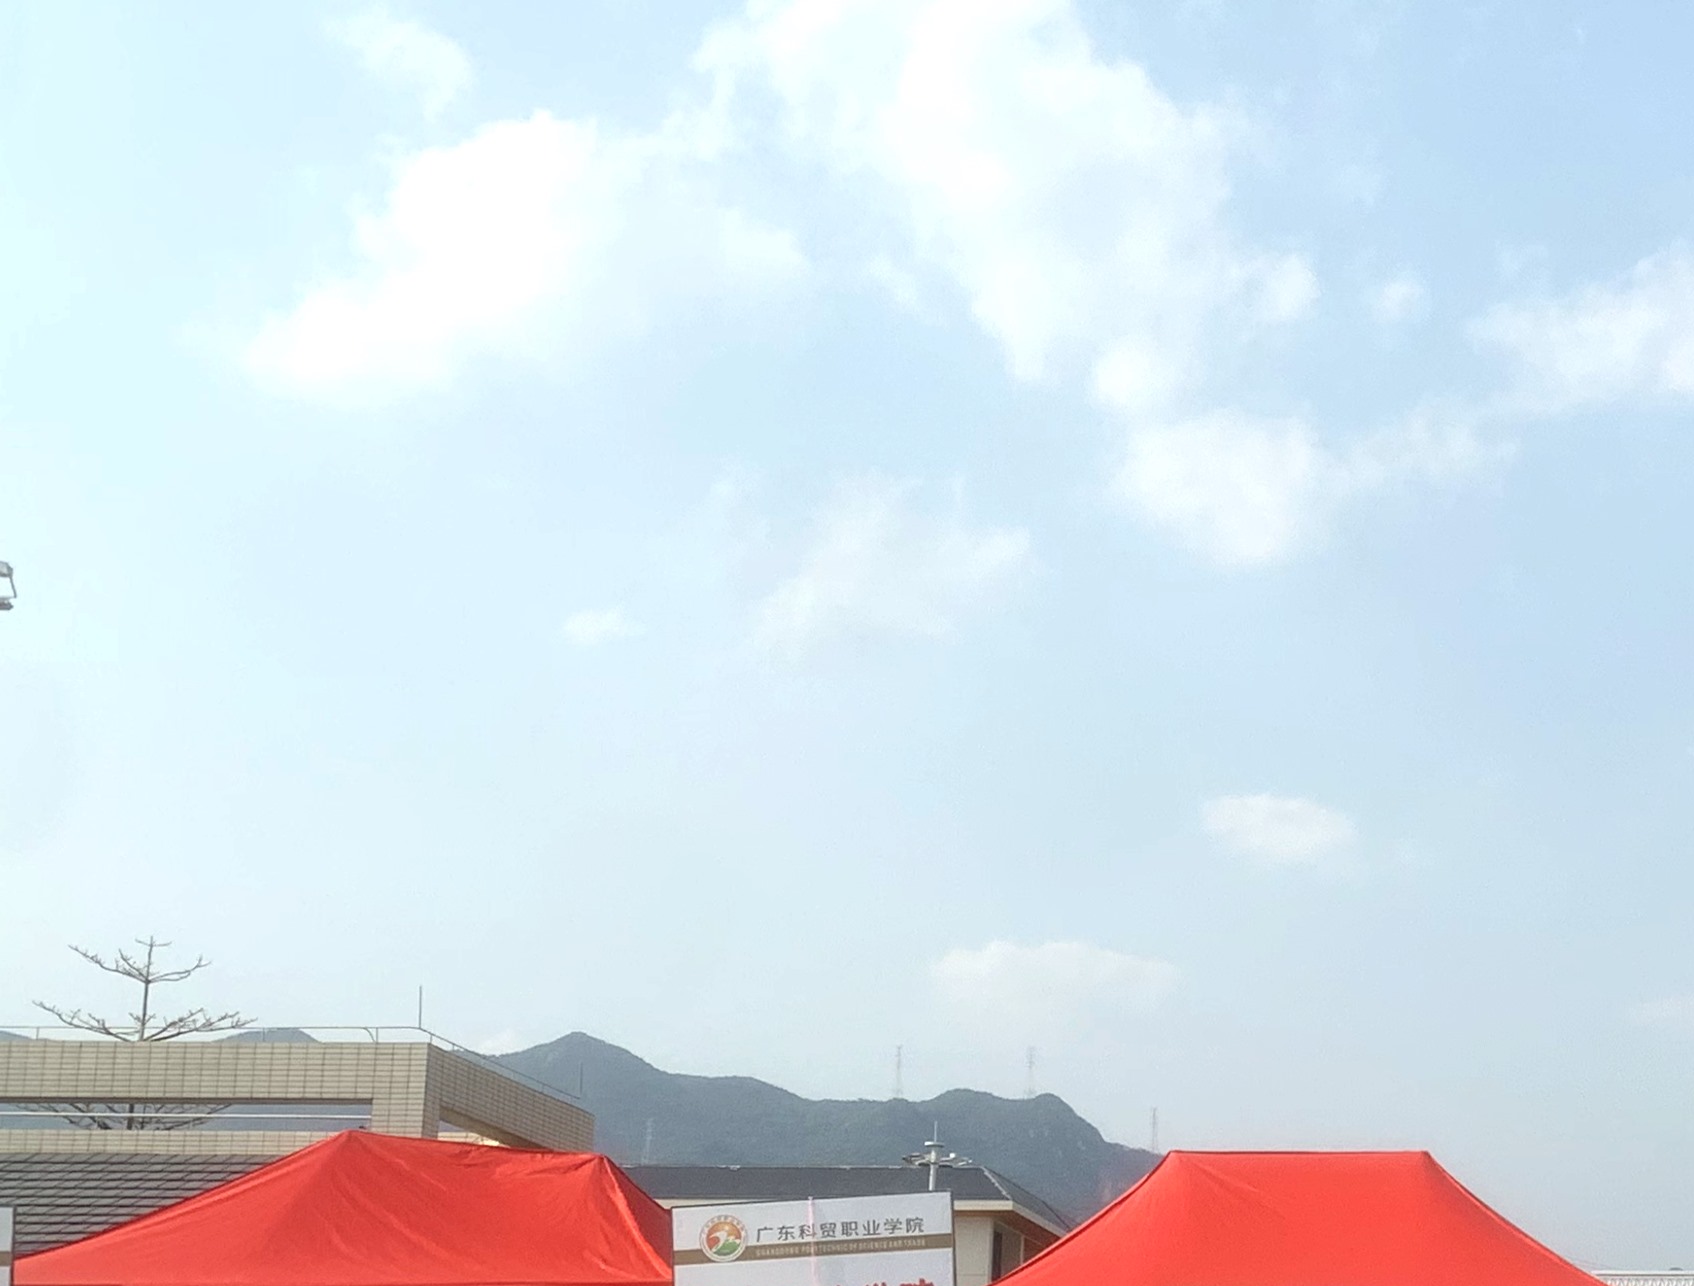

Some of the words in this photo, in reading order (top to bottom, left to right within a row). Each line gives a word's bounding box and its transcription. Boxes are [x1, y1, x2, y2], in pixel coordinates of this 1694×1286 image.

[756, 1217, 925, 1243] 广东科贸职业学院
